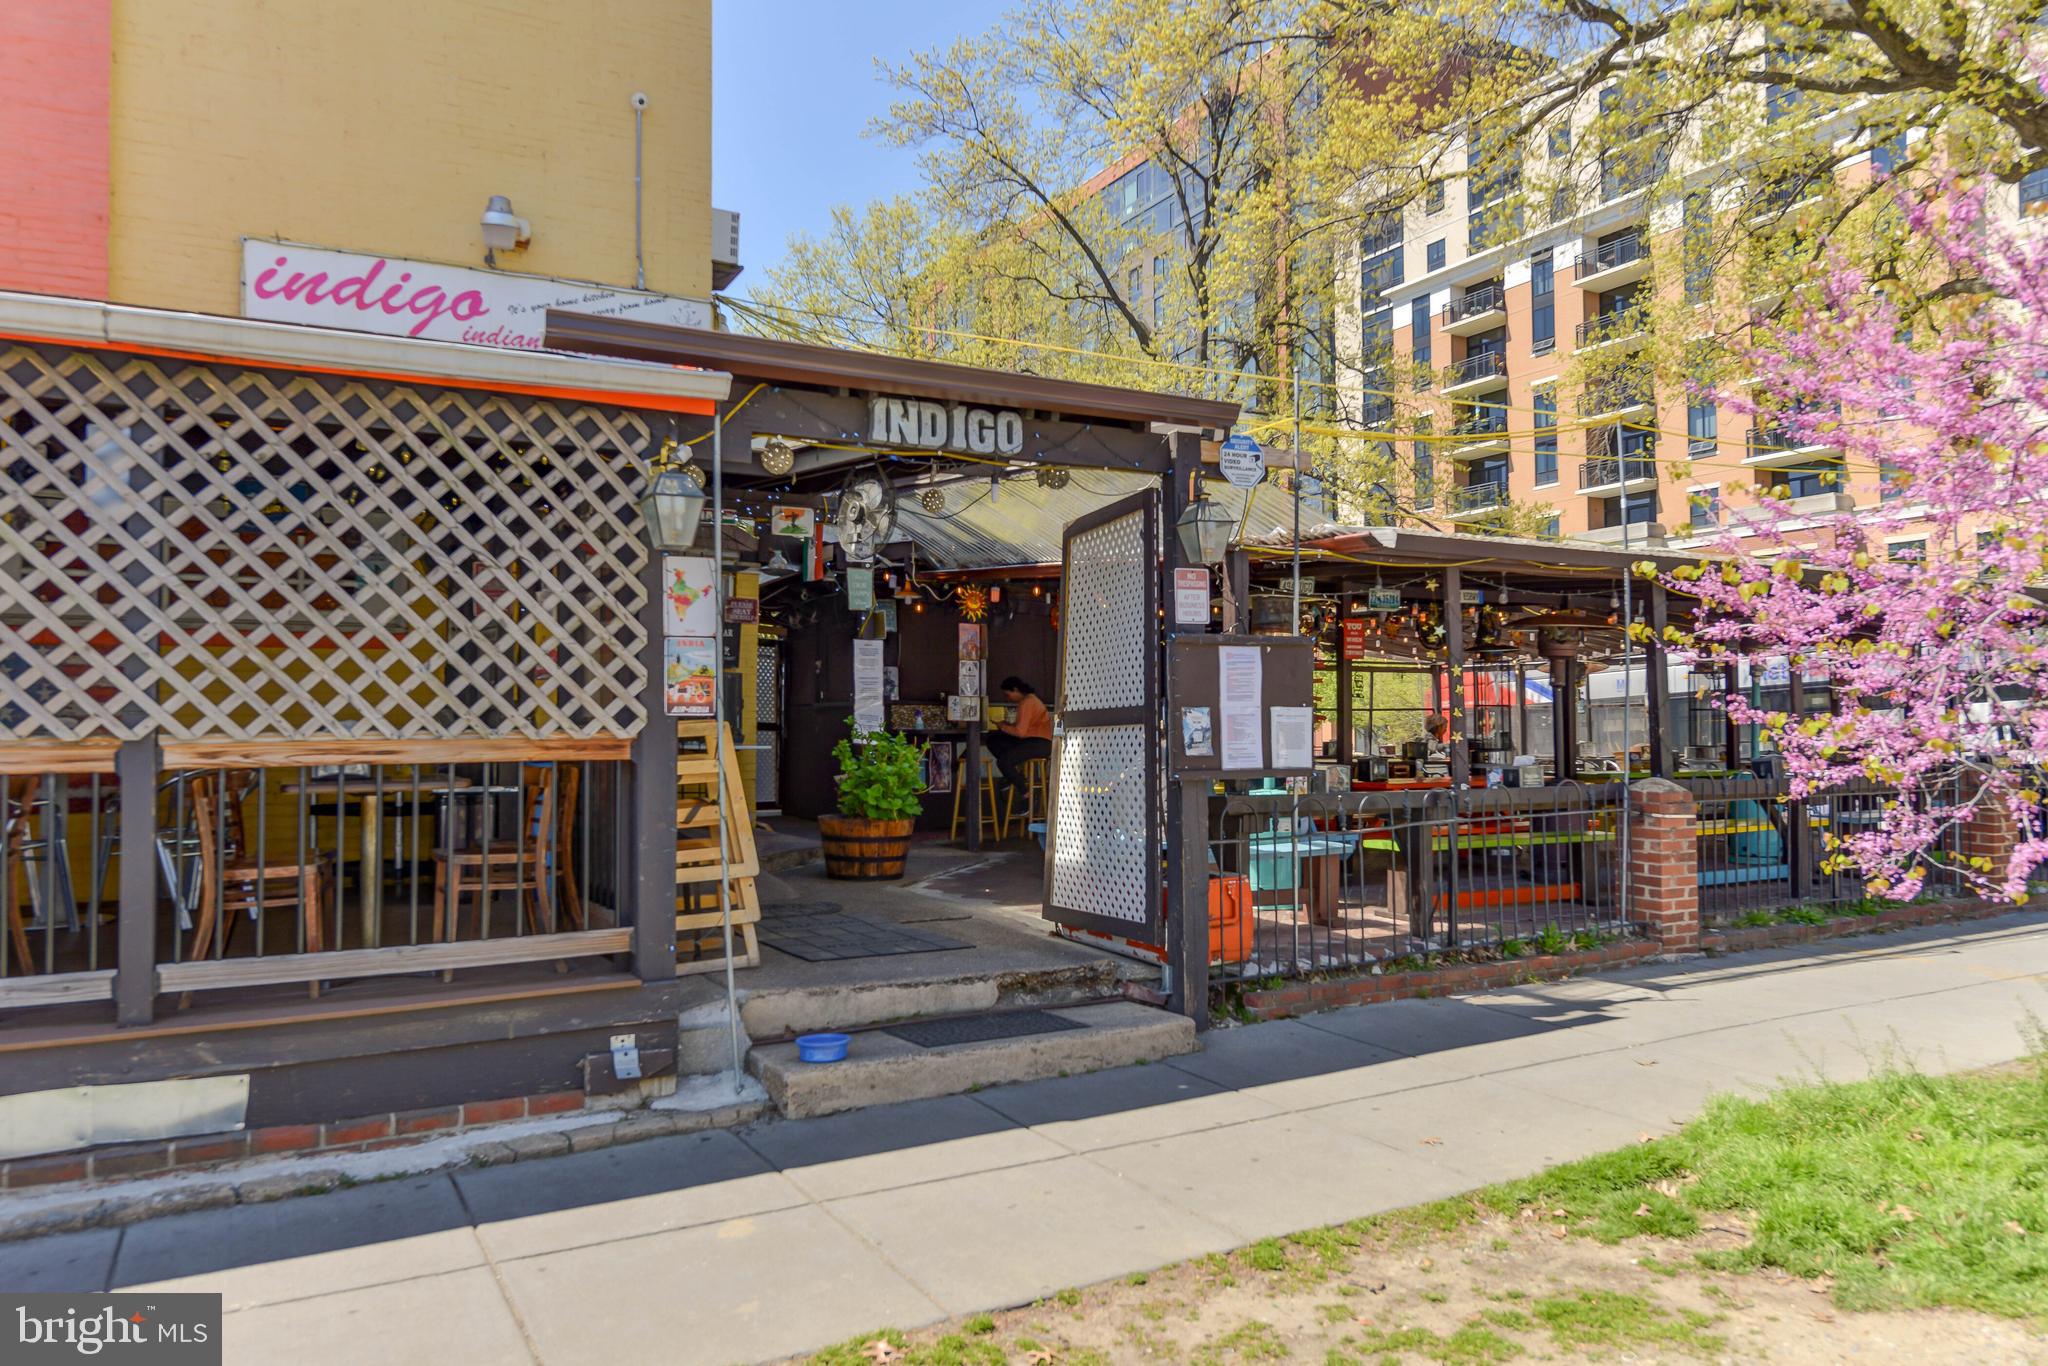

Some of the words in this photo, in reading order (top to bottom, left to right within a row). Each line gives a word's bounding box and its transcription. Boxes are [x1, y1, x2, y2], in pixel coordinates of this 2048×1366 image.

[254, 256, 490, 336] indigo
[582, 290, 616, 304] kitchen
[462, 325, 542, 349] indian
[872, 397, 1024, 455] INDIGO
[1184, 593, 1201, 601] AFTER
[1345, 622, 1362, 630] YOU
